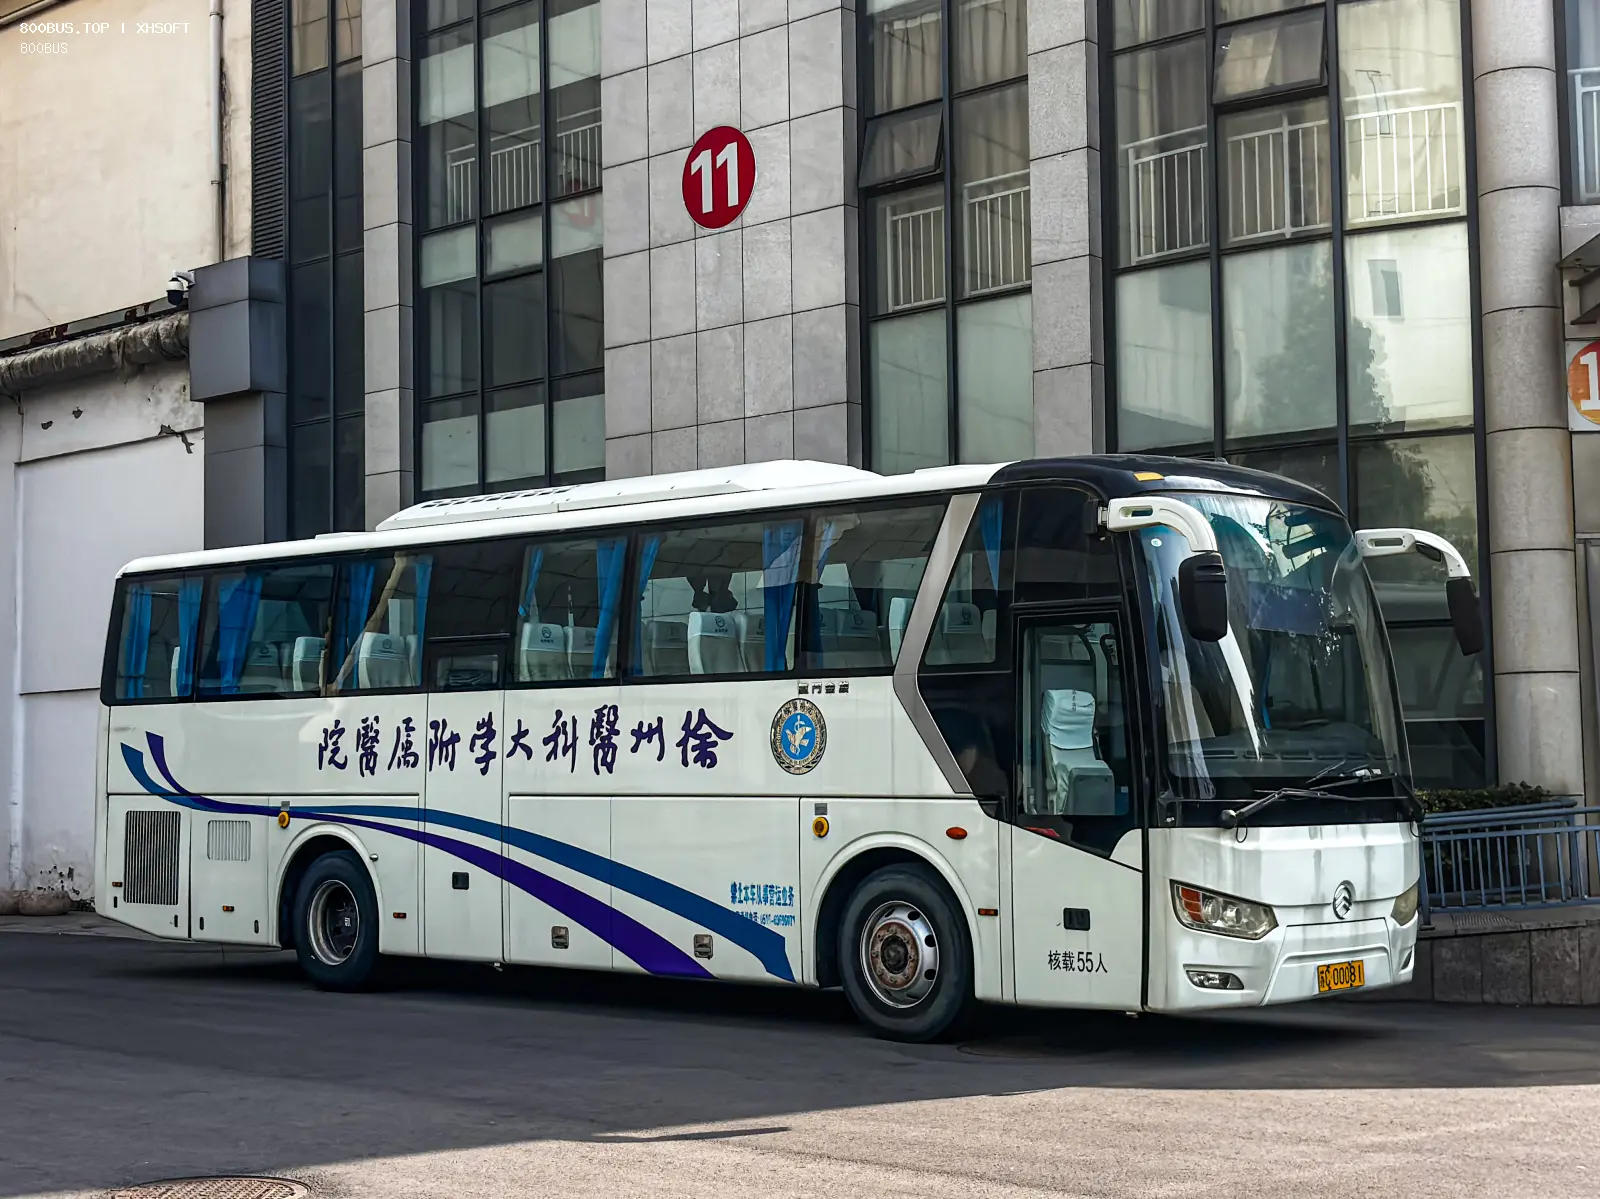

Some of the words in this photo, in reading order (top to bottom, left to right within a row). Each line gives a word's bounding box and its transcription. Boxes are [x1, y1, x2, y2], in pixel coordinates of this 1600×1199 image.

[691, 141, 739, 214] 11
[1048, 950, 1108, 973] 核载55人
